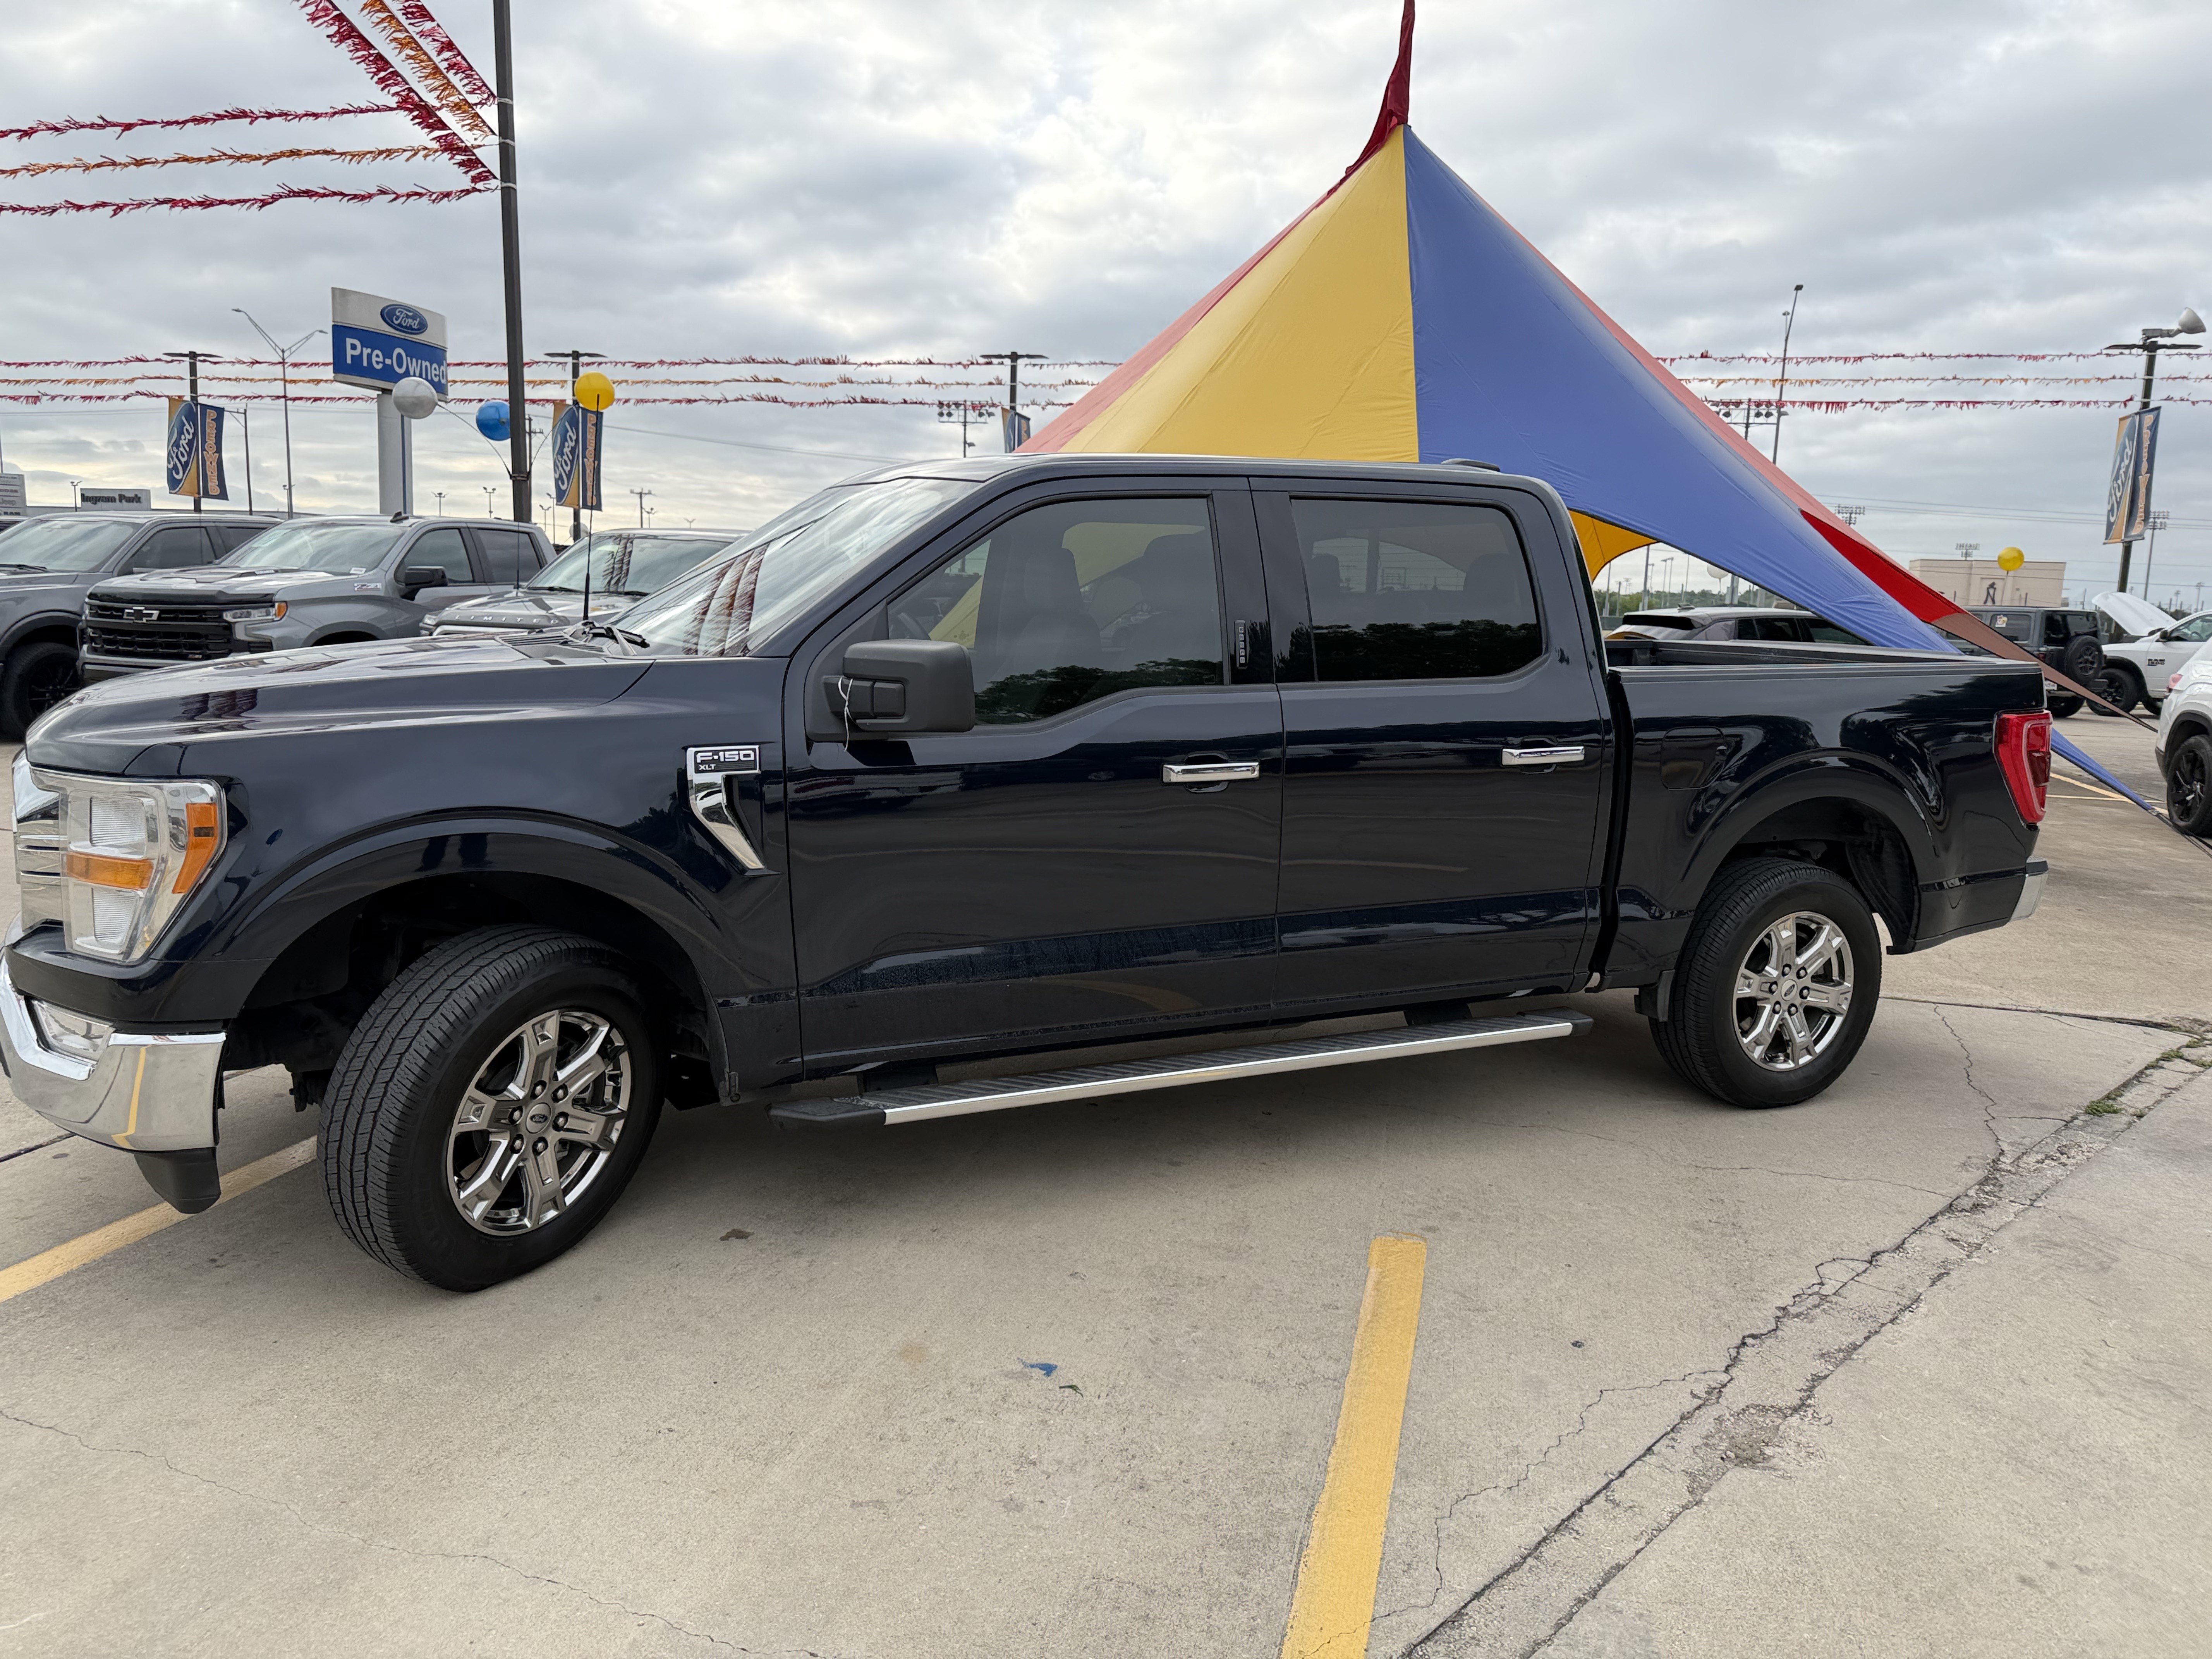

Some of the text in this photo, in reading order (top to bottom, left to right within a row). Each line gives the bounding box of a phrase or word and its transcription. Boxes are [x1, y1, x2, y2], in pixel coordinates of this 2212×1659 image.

[393, 308, 420, 329] Ford
[346, 337, 446, 385] Pre-Owned
[167, 415, 194, 479] Ford
[203, 409, 220, 495] PREOWNED
[554, 421, 577, 490] Ford
[81, 493, 142, 505] Ingram Park
[2107, 436, 2132, 523] Ford
[455, 615, 559, 625] LIMITED
[696, 750, 755, 763] F-150
